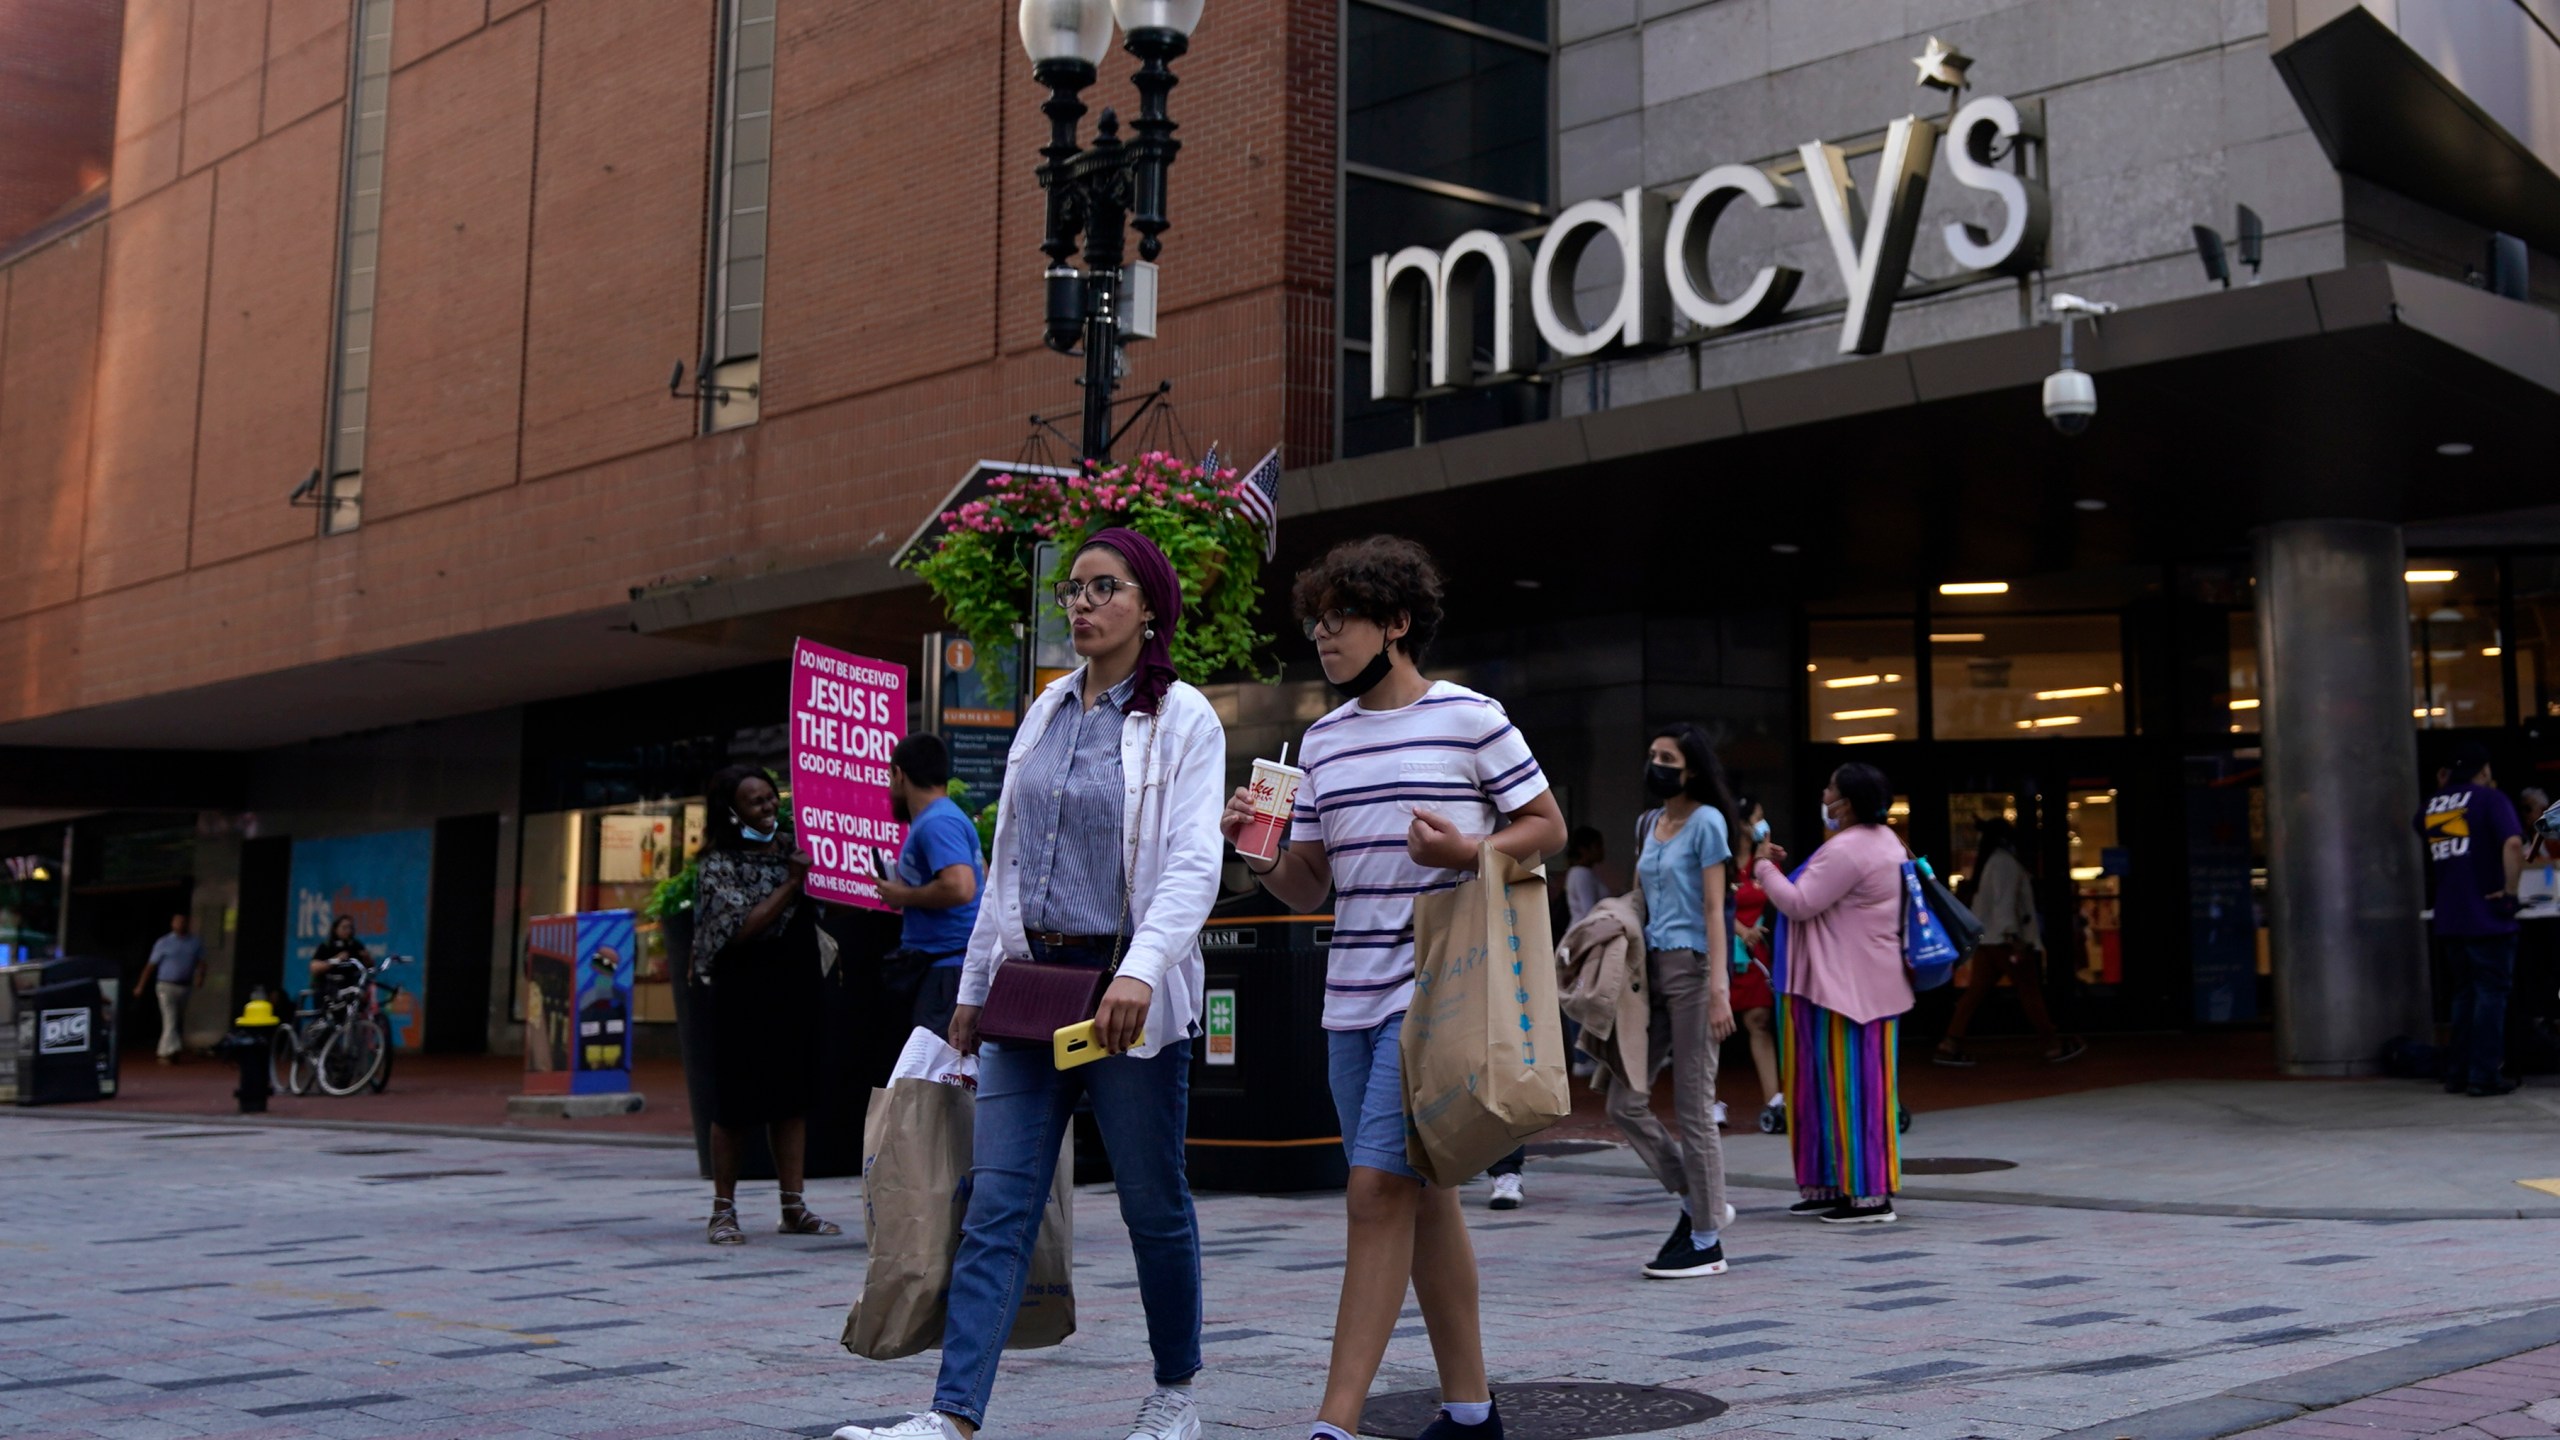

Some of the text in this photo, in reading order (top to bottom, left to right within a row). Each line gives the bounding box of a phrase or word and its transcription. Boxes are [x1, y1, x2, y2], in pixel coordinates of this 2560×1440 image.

[801, 650, 899, 690] DO NOT BE DECEIVED
[807, 676, 890, 726] JESUS IS
[797, 711, 899, 763] THE LORD
[799, 752, 891, 788] GOD OF ALL FLES
[802, 806, 901, 845] GIVE YOUR LIFE
[807, 834, 838, 869] TO
[808, 872, 827, 889] FOR
[826, 876, 838, 892] HE
[838, 878, 846, 893] IS
[1199, 931, 1239, 946] TRASH
[1027, 1283, 1069, 1297] this bag
